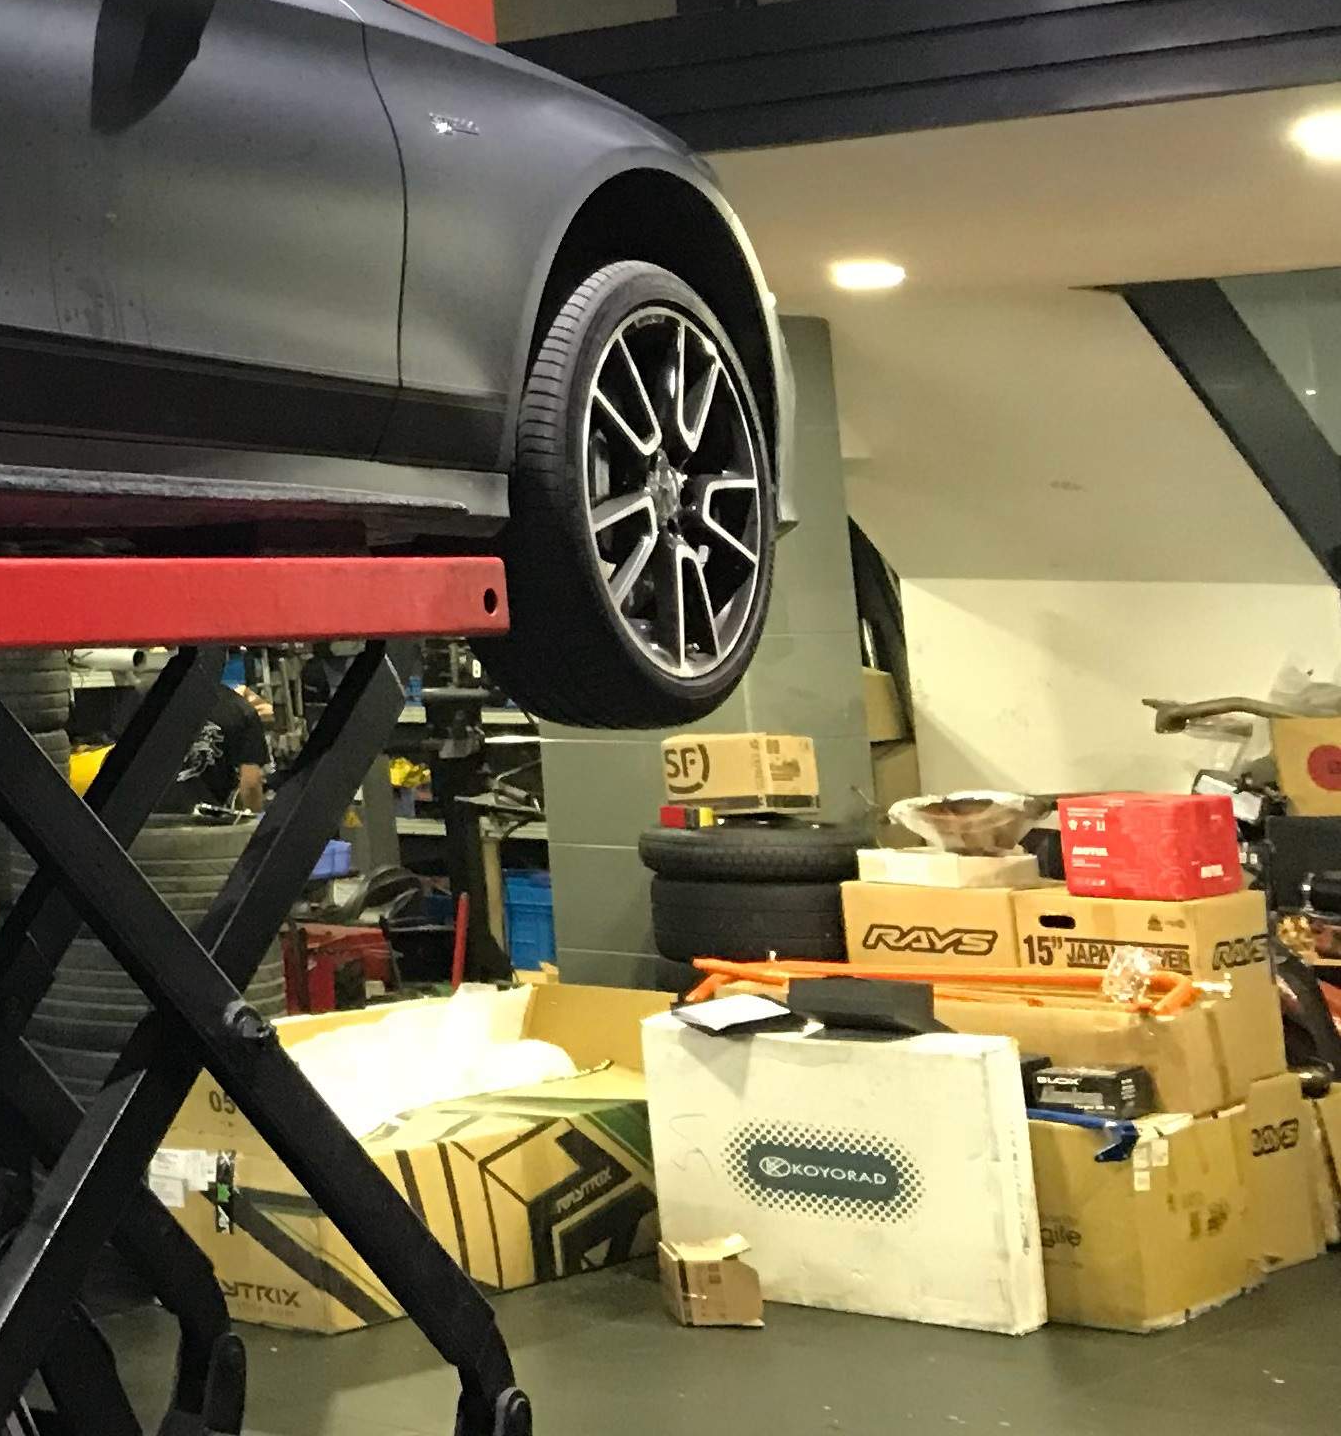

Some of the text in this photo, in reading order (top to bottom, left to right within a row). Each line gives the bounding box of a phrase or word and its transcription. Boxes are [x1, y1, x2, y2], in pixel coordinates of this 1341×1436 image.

[863, 923, 999, 956] RAYS
[1067, 941, 1116, 965] JAPA
[791, 1163, 887, 1186] KOYORAD
[220, 1278, 302, 1309] YTRIX
